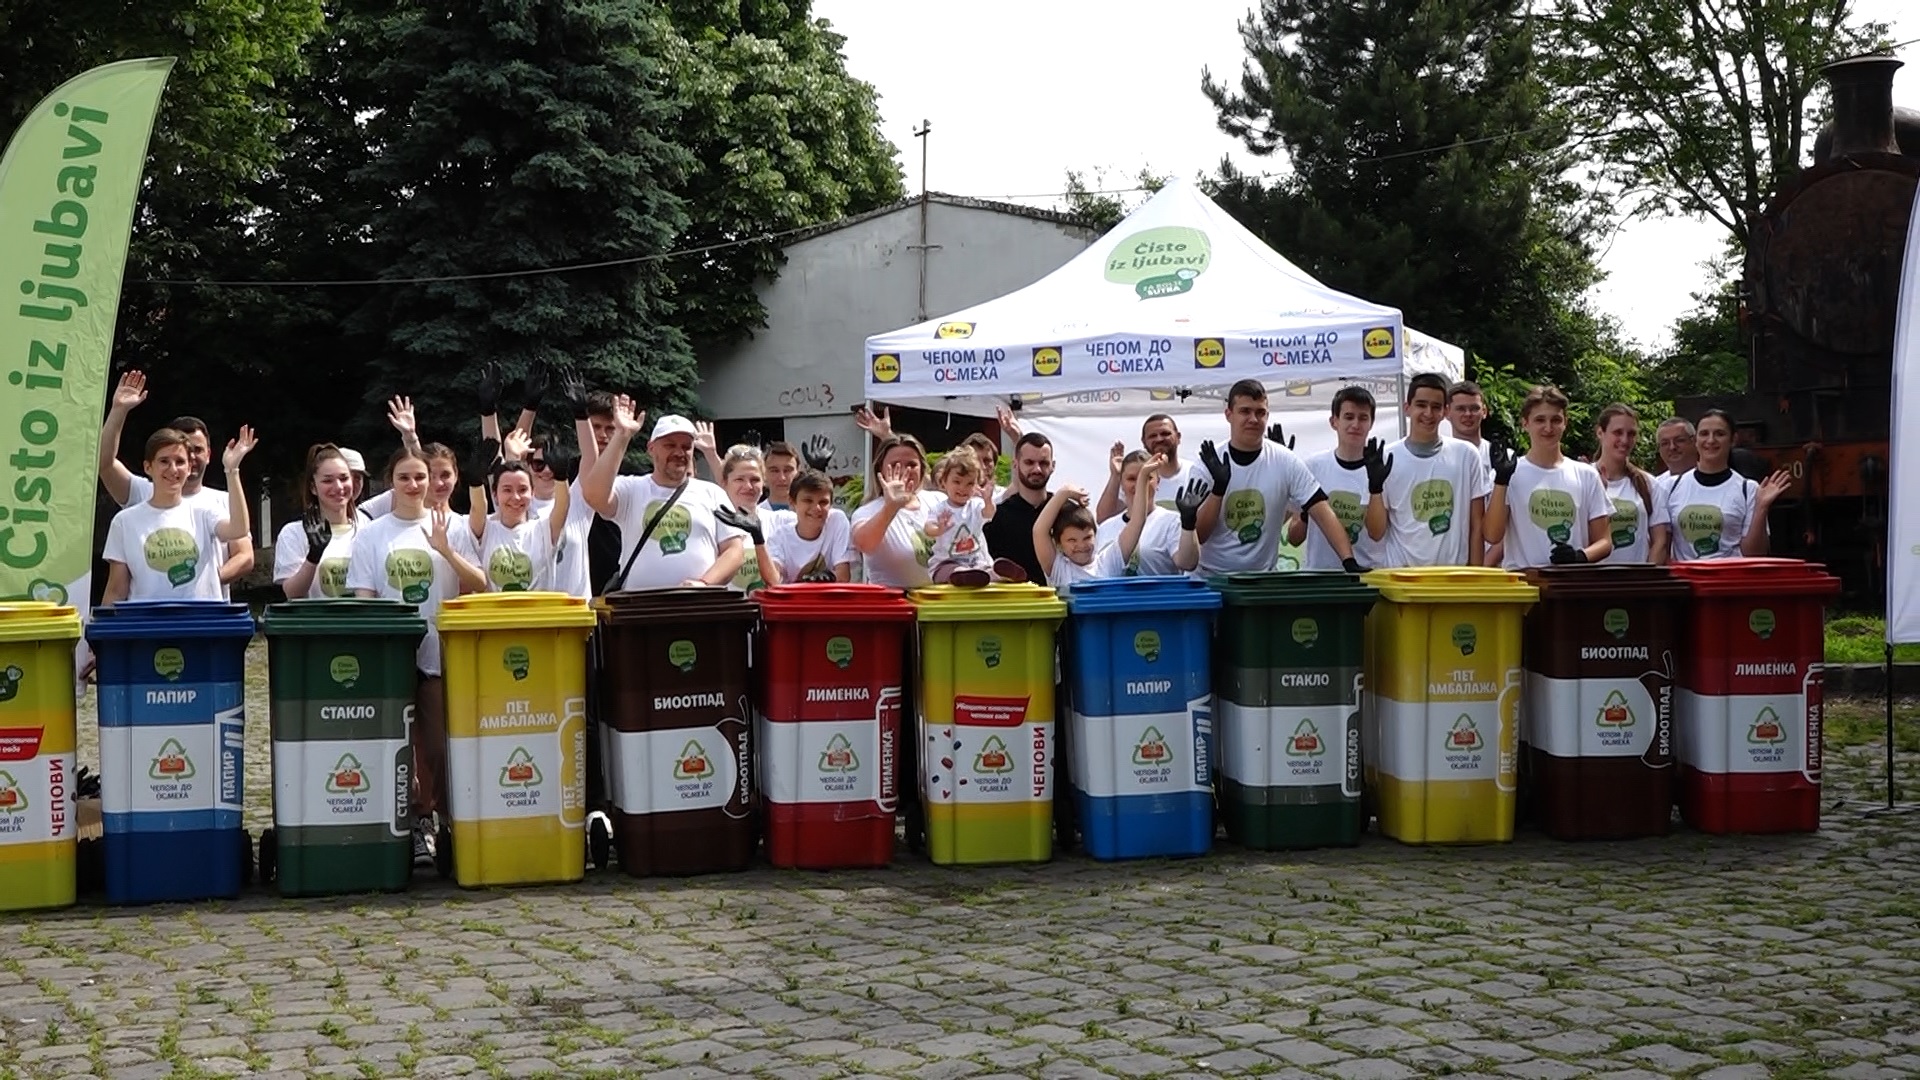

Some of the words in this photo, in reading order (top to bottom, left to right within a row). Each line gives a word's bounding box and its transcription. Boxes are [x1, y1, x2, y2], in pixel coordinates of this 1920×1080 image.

[19, 102, 109, 322] ljubavi
[1134, 242, 1187, 255] Čisto
[1110, 259, 1126, 270] iz
[1132, 253, 1206, 270] ljubavi
[1314, 332, 1338, 346] ДО
[922, 350, 976, 366] ЧЕПОМ
[983, 348, 1006, 365] ДО
[1085, 340, 1142, 358] ЧЕПОМ
[1148, 339, 1172, 357] ДО
[8, 340, 67, 391] iz
[1581, 647, 1649, 661] БИООТПАД
[1452, 670, 1475, 682] ПЕТ
[1735, 663, 1796, 676] ЛИМЕНКА
[1126, 681, 1171, 695] ПАПИР
[1281, 673, 1329, 687] СТАКЛО
[1428, 681, 1498, 695] АМБАЛАЖА
[146, 690, 197, 705] ПАПИР
[654, 692, 725, 710] БИООТПАД
[806, 687, 869, 702] ЛИМЕНКА
[320, 706, 375, 720] СТАКЛО
[506, 701, 530, 714] ПЕТ
[479, 712, 557, 730] АМБАЛАЖА
[1659, 685, 1671, 756] БИООТПАД
[1809, 704, 1820, 767] ЛИМЕНКА
[882, 730, 893, 795] ЛИМЕНКА
[1033, 726, 1046, 797] ЧЕПОВИ
[1196, 736, 1208, 782] ПАПИР
[1348, 728, 1359, 780] СТАКЛО
[223, 751, 235, 799] ПАПИР
[738, 731, 749, 804] БИООТПАД
[181, 783, 192, 791] ДО
[397, 764, 409, 817] СТАКЛО
[50, 758, 64, 837] ЧЕПОВИ
